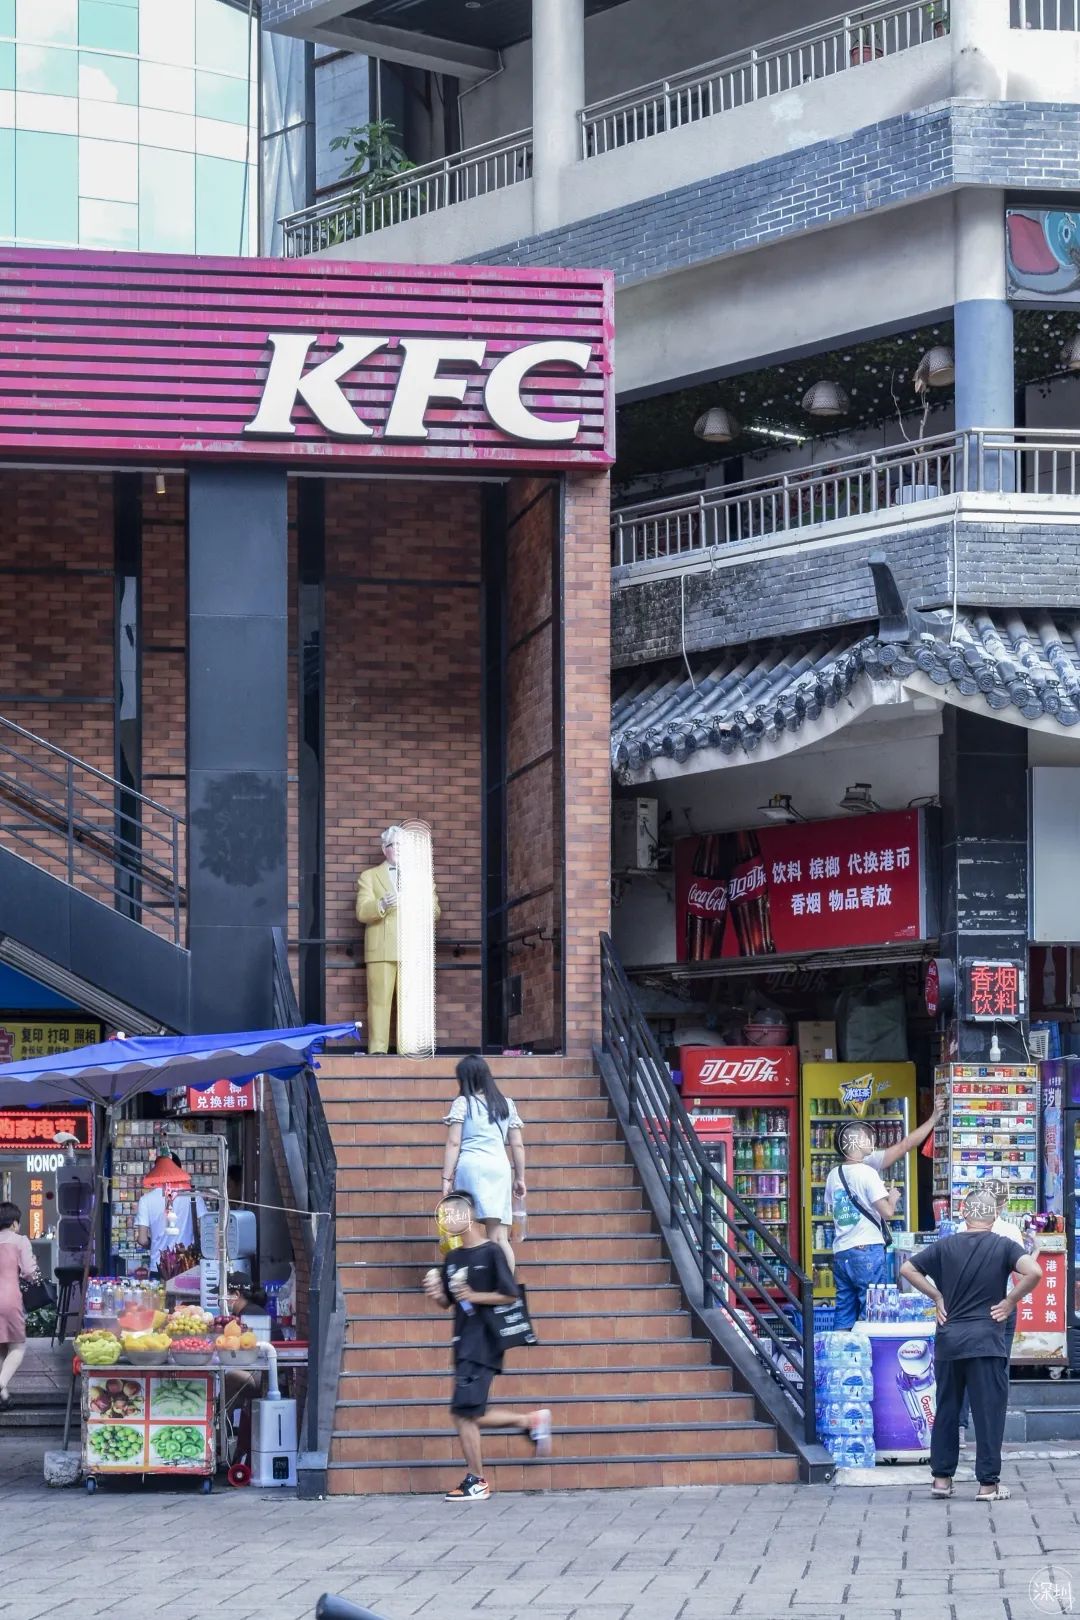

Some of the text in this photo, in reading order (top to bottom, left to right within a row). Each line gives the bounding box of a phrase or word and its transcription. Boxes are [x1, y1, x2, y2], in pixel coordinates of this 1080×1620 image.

[244, 333, 593, 442] KFC
[772, 846, 910, 884] 饮料 槟榔 代换港币
[791, 884, 892, 916] 香烟 物品寄放
[971, 967, 1017, 991] 香烟
[971, 991, 1017, 1015] 饮料
[21, 1028, 96, 1044] 复印 打印 照相
[699, 1057, 782, 1085] 可口可乐
[197, 1095, 248, 1109] 兑换港币
[1045, 1260, 1057, 1323] 港币兑换
